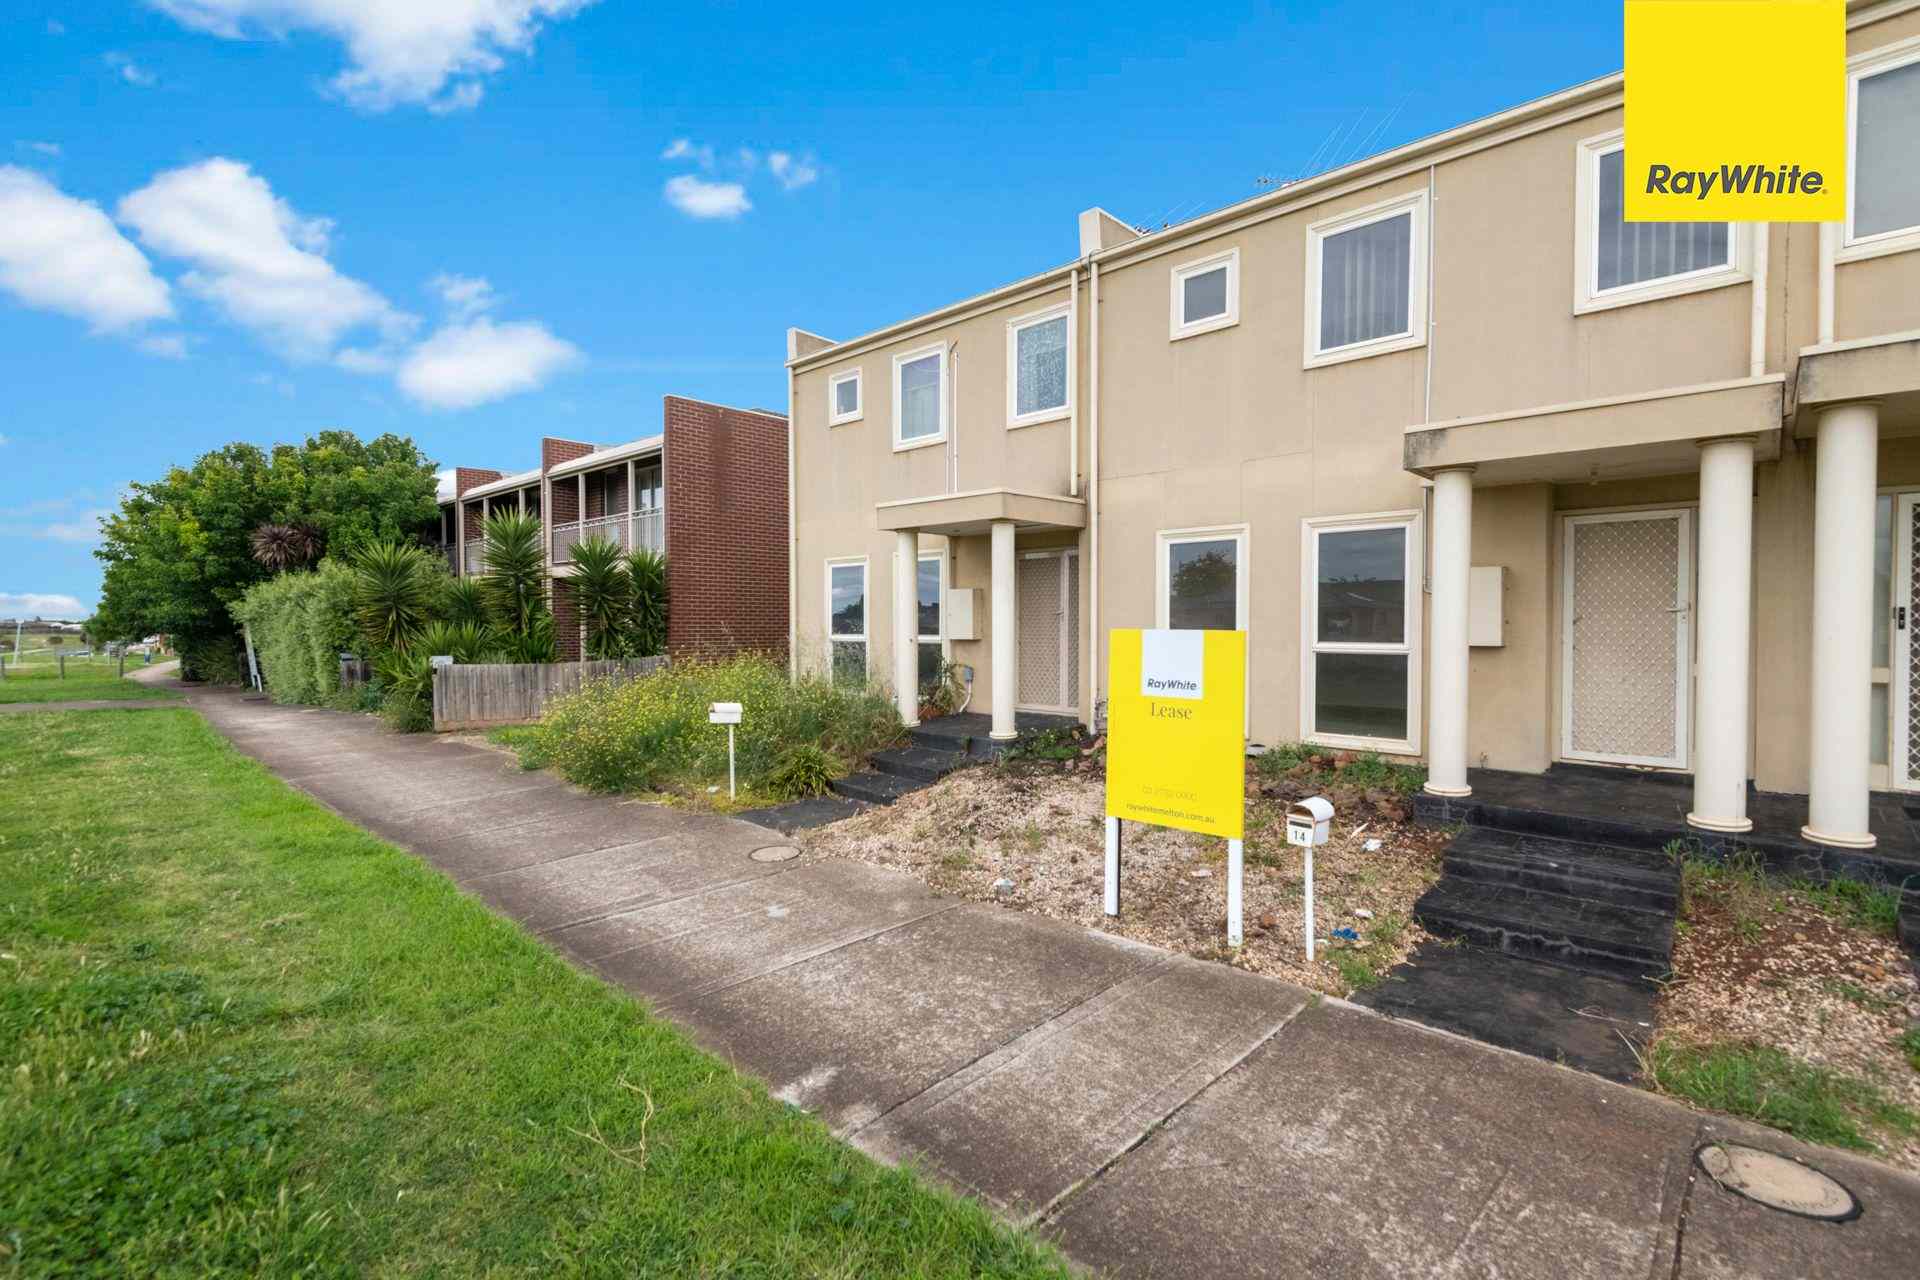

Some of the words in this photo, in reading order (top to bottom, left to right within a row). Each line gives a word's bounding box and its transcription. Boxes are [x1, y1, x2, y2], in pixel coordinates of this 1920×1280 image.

[1147, 678, 1198, 691] RayWhite
[1151, 702, 1193, 720] Lease
[1126, 803, 1216, 824] raywhitemelton.com.au
[1293, 830, 1305, 842] 14
